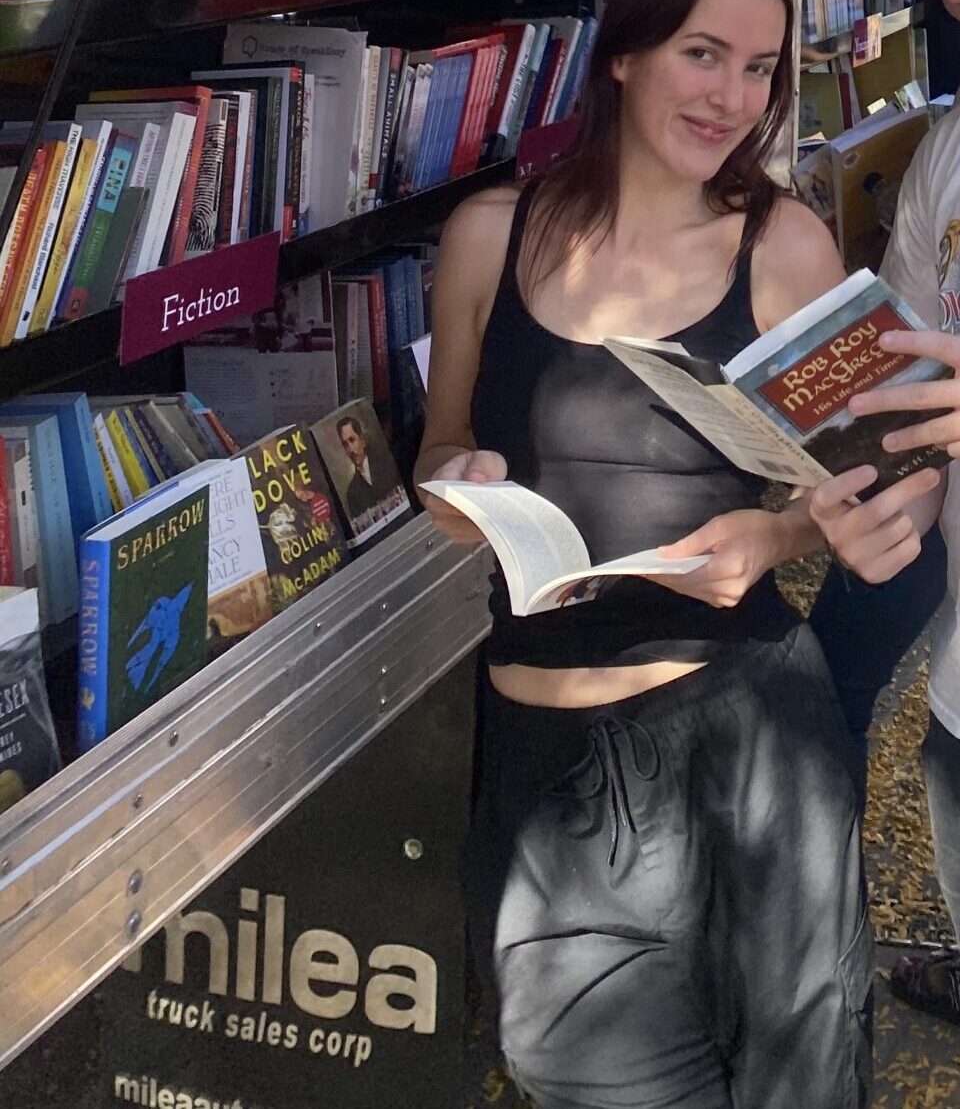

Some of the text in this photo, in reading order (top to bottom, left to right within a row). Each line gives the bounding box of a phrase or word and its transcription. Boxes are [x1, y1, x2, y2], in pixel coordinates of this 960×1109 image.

[381, 72, 397, 159] SMALL ANIMALS
[161, 284, 240, 332] Fiction
[783, 321, 877, 390] ROB ROY
[813, 354, 905, 415] His Life and Times
[253, 462, 311, 513] DOVE
[117, 498, 206, 571] SPARROW
[82, 559, 99, 675] SPARROW
[121, 888, 438, 1034] milea
[146, 989, 373, 1068] truck sales corp
